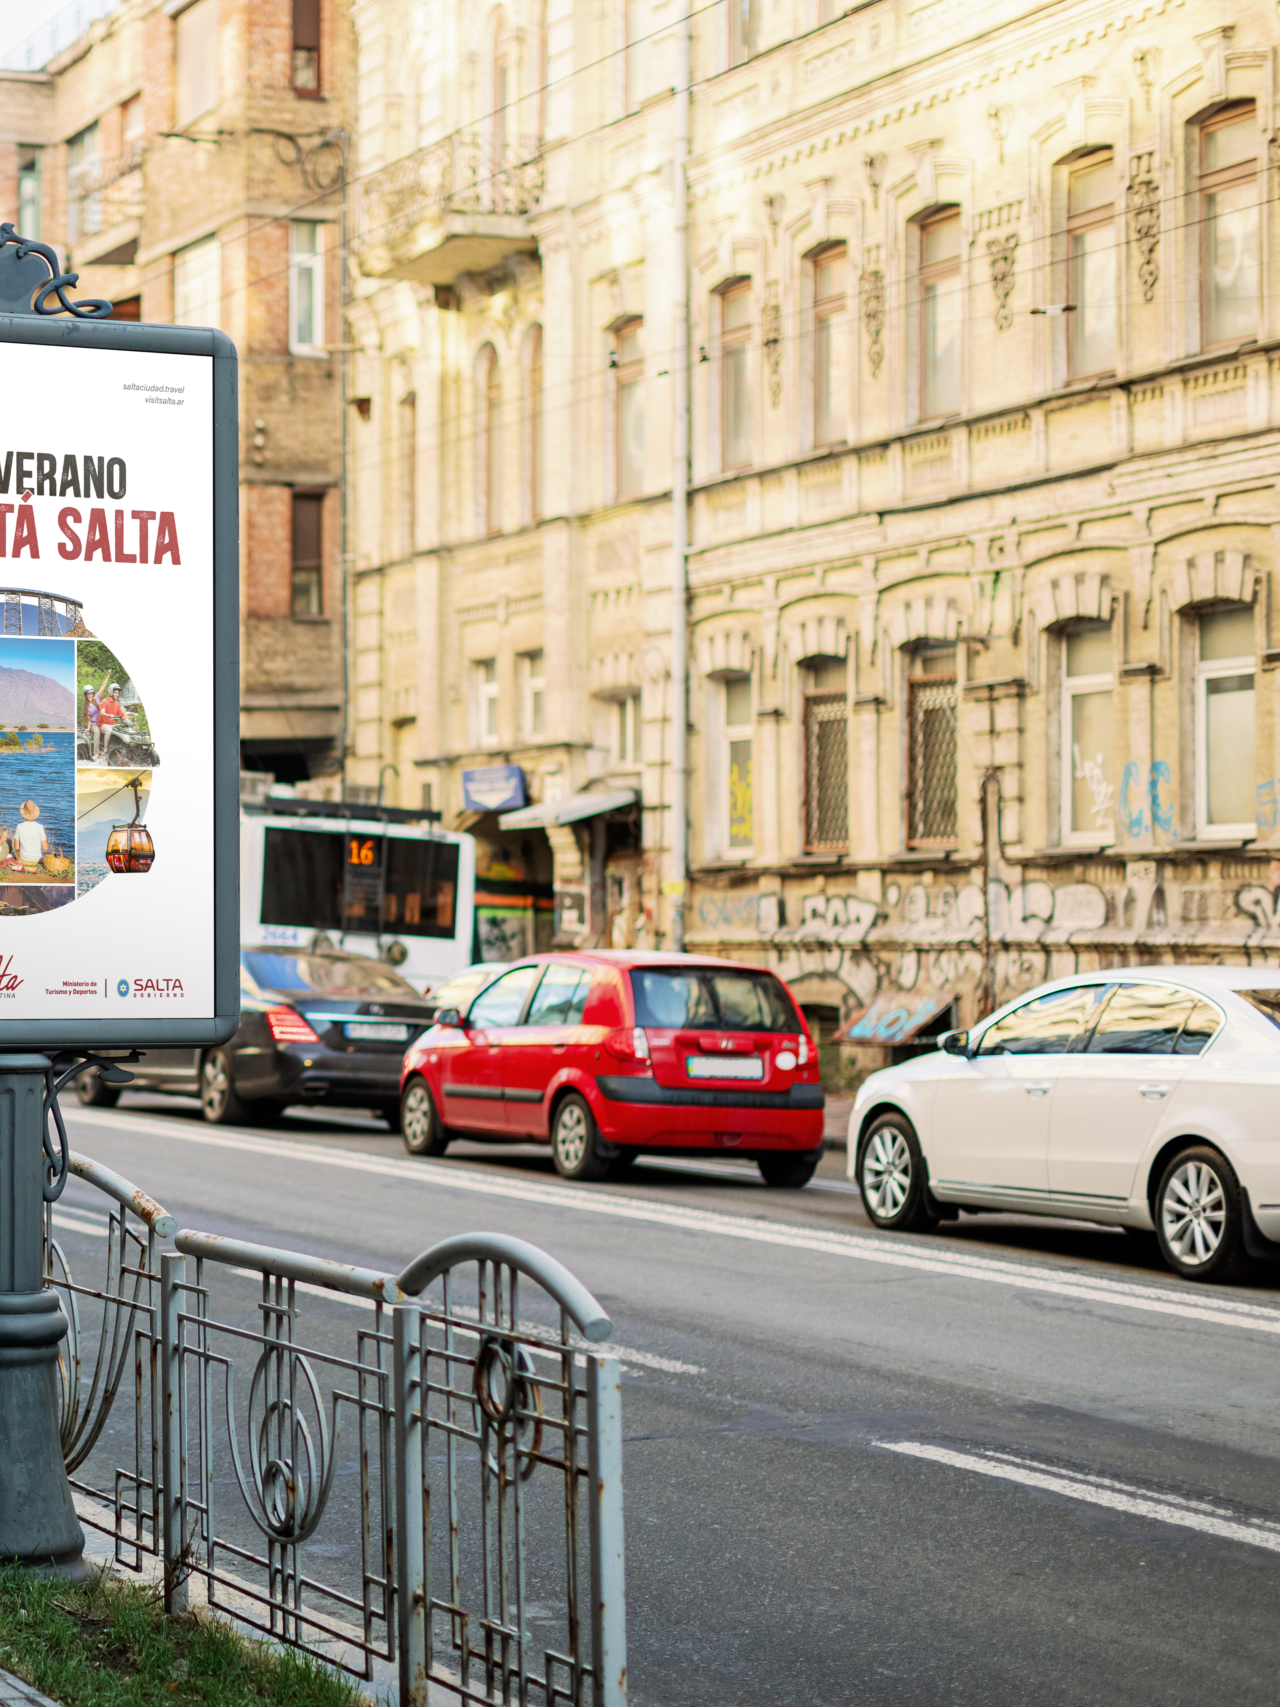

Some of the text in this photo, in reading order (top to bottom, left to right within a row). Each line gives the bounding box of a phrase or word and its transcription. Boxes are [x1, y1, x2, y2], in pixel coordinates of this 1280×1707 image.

[122, 382, 185, 394] saltaciudad.travel
[144, 396, 185, 406] visitsalta.ar
[57, 506, 182, 566] SALTA
[348, 839, 375, 866] 16
[62, 980, 89, 988] Ministerio
[133, 978, 184, 992] SALTA
[45, 988, 67, 996] Turismo
[72, 988, 98, 996] Deportes
